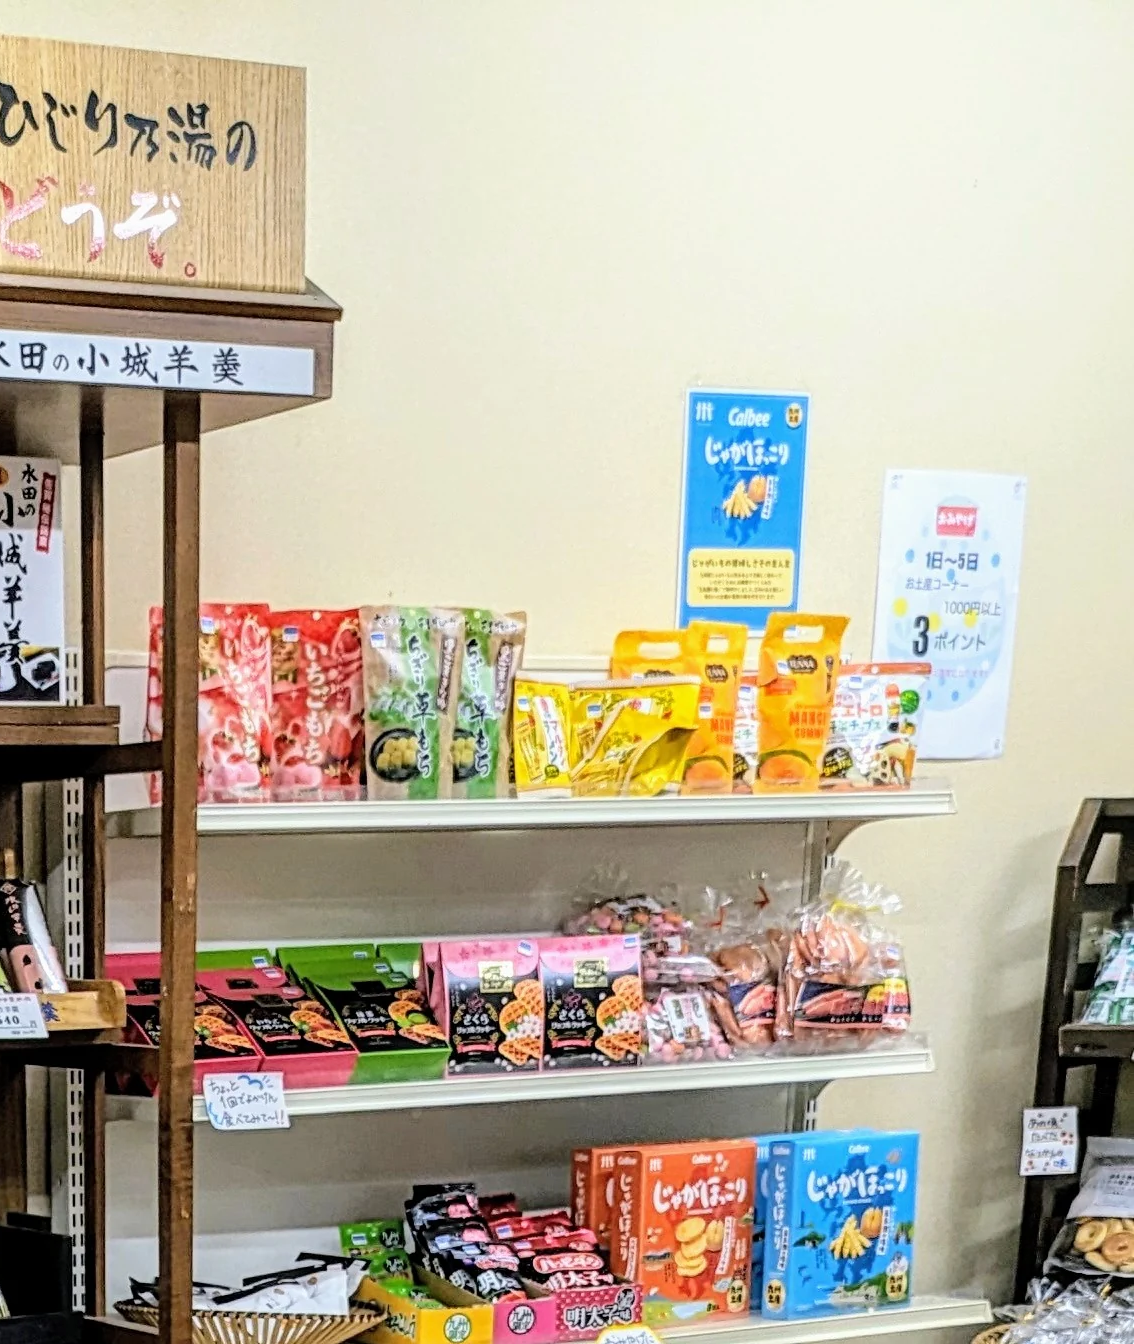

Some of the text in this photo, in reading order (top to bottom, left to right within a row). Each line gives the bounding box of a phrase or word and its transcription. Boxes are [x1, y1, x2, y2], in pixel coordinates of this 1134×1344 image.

[728, 408, 770, 427] Calbee
[704, 436, 789, 466] じゃがほっこり
[21, 463, 39, 517] 水田の
[905, 577, 969, 592] お土産コーナー
[944, 601, 1002, 617] 1000円以上
[912, 615, 986, 657] 3 ポイント
[788, 711, 826, 726] MANG
[209, 1081, 239, 1095] ちょっと
[653, 1178, 746, 1214] じゃがほっこり
[807, 1166, 908, 1203] じゃがほっこり
